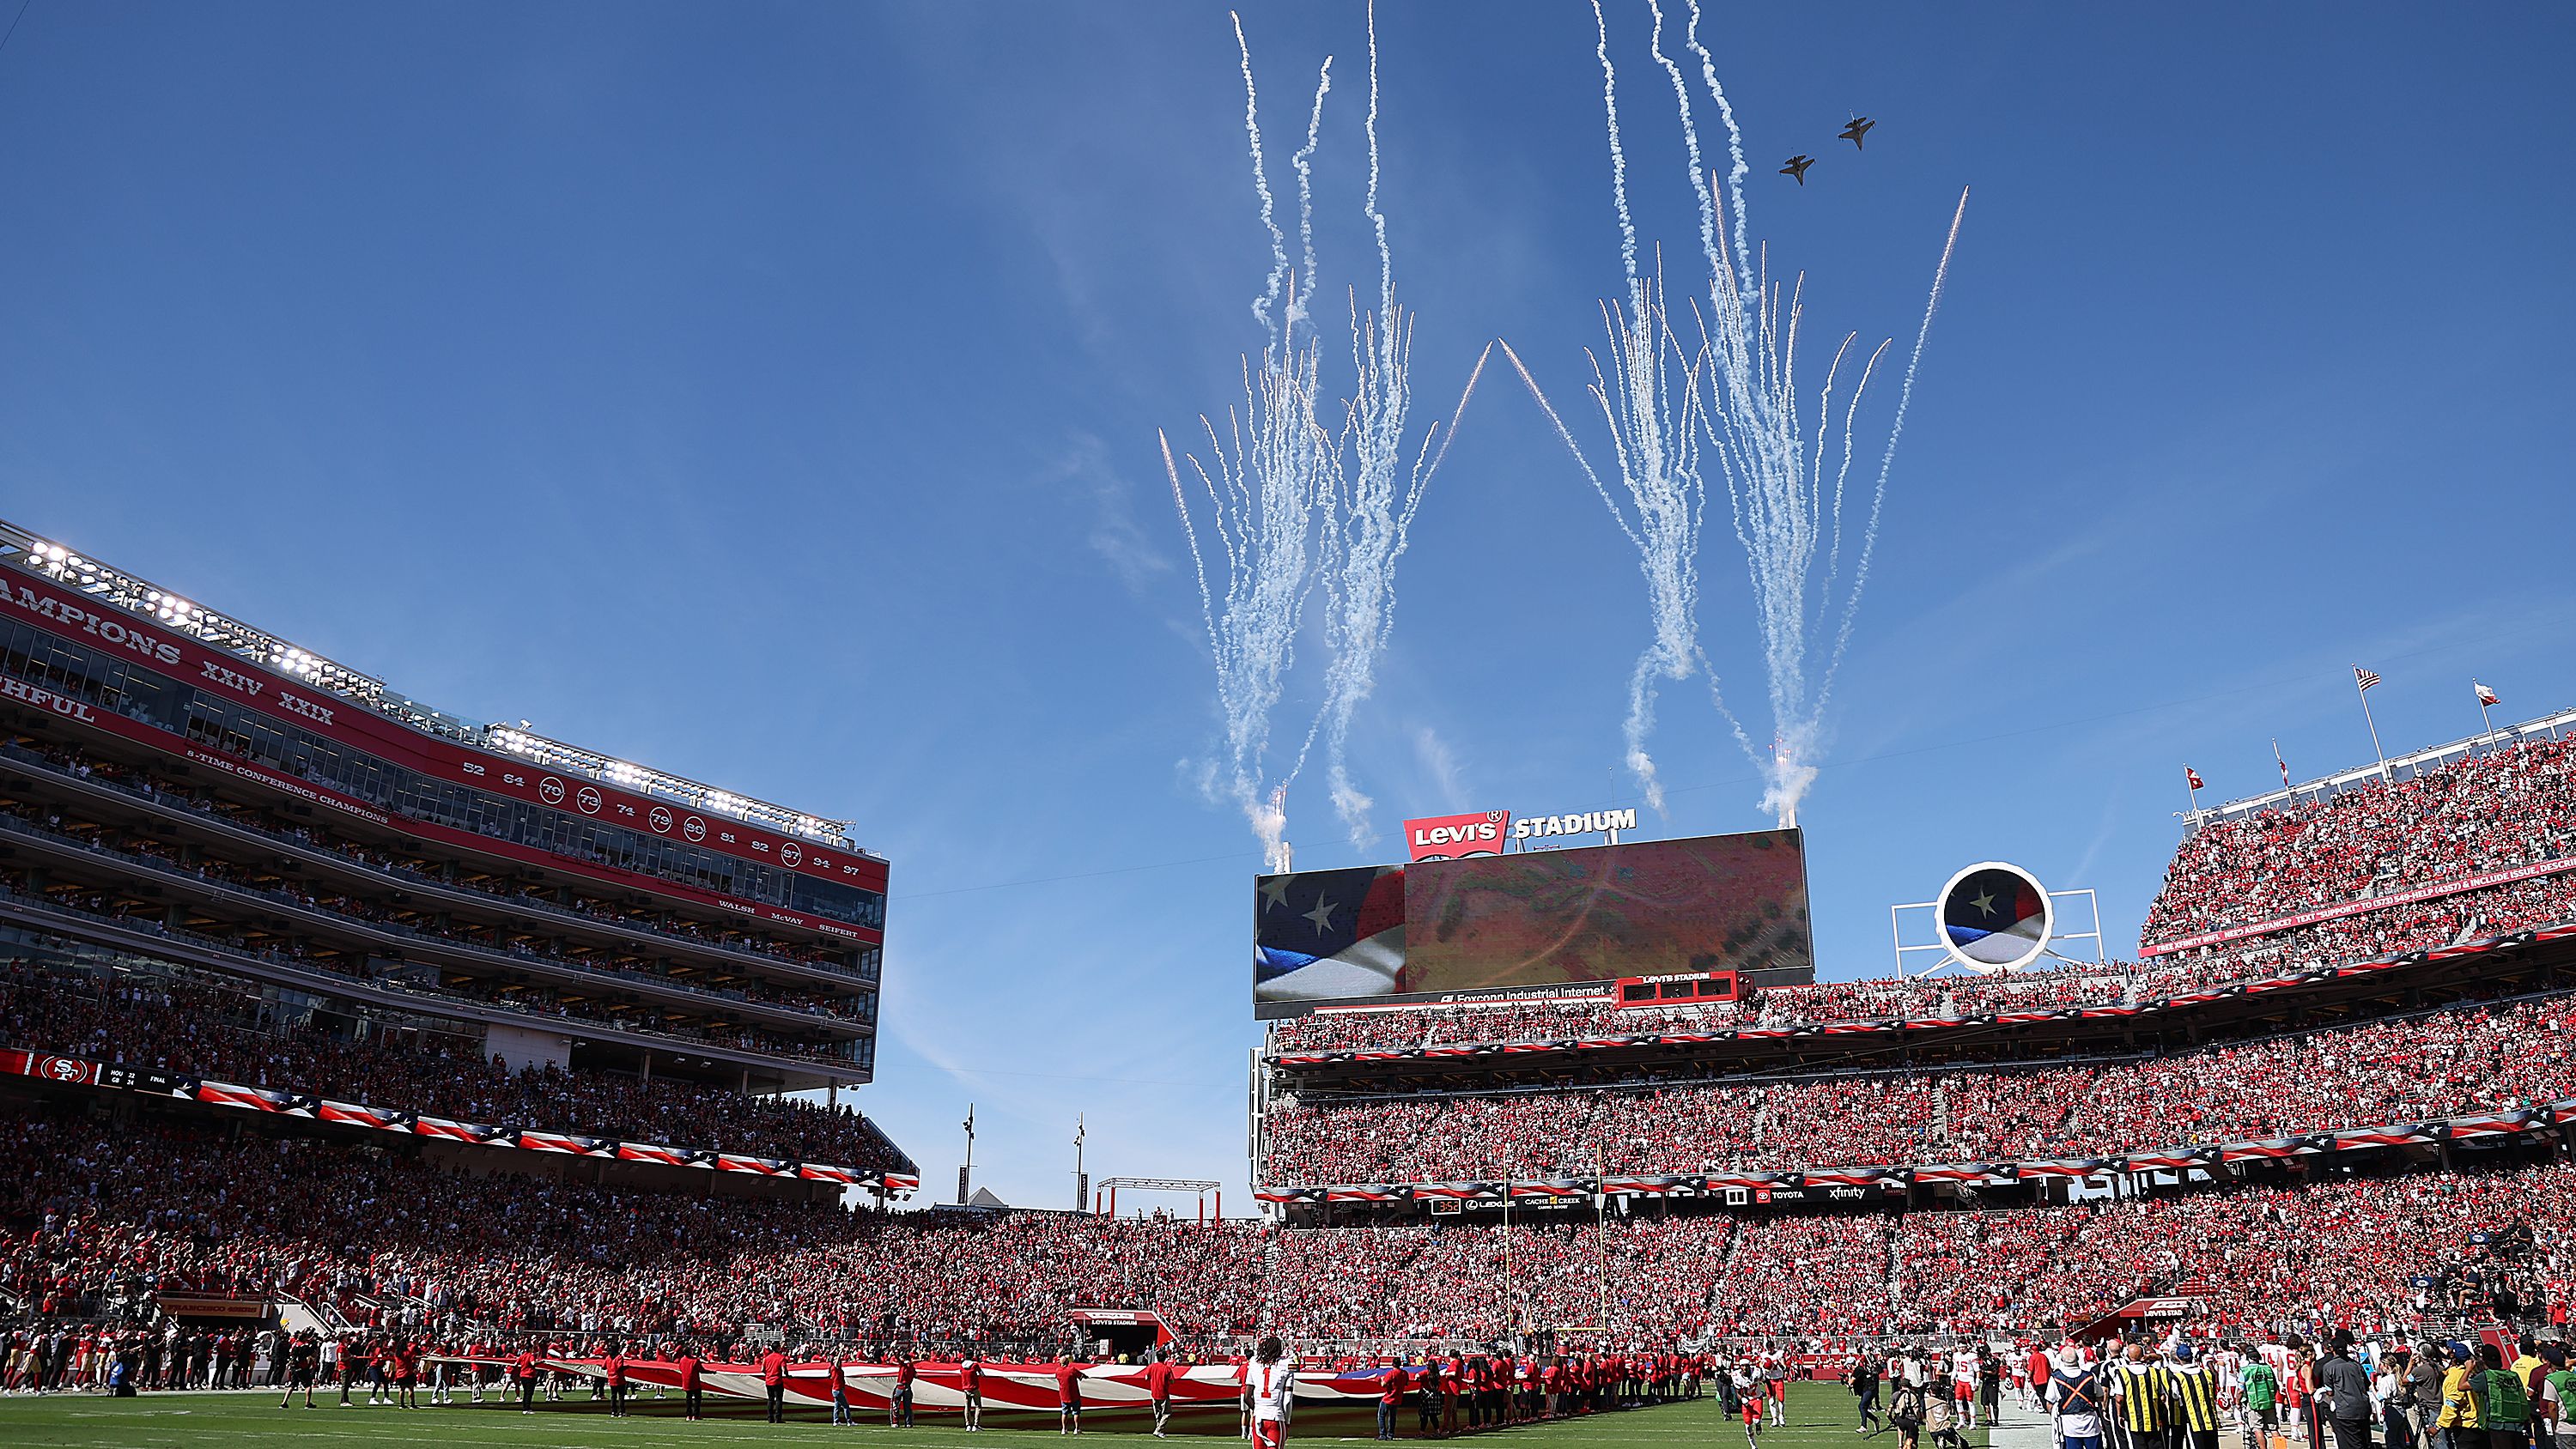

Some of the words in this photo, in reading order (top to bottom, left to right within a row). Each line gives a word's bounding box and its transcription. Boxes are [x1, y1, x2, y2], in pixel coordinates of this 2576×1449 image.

[0, 579, 181, 665] AMPIONS
[200, 660, 264, 696] XXIV
[278, 691, 334, 726] XXIX
[0, 676, 94, 723] HFUL
[463, 761, 485, 776] 52
[186, 749, 234, 772] 8-TIME
[236, 766, 317, 801] CONFERENCE
[319, 795, 389, 824] CHAMPIONS
[503, 773, 525, 787] 64
[617, 803, 635, 816] 74
[1512, 808, 1637, 839] STADIUM
[720, 832, 736, 844] 81
[813, 858, 830, 868] 94
[843, 865, 860, 876] 97
[2156, 943, 2175, 953] FREE
[2174, 937, 2202, 949] XFINITY
[2224, 929, 2244, 940] NEED
[2244, 919, 2292, 935] ASSISTANCE?
[2295, 913, 2316, 924] TEXT
[2360, 901, 2372, 911] TO
[2372, 895, 2394, 908] (573)
[2394, 888, 2433, 903] 549-HELP
[2434, 882, 2462, 894] (4357)
[2470, 873, 2510, 887] INCLUDE
[2510, 866, 2540, 879] ISSUE,
[2540, 858, 2576, 872] DESCRI
[719, 900, 755, 914] WALSH
[771, 912, 804, 925] McVAY
[818, 924, 858, 938] SEIFERT
[1674, 972, 1710, 982] STADIUM
[1457, 993, 1504, 1003] Foxconn
[1506, 988, 1558, 1001] Industrial
[1561, 985, 1606, 998] Internet
[149, 1076, 166, 1084] FINAL
[1771, 1191, 1804, 1199] TOYOTA
[1829, 1186, 1866, 1200] xfinity
[1440, 1201, 1459, 1212] 3:52
[1261, 1367, 1272, 1398] 1
